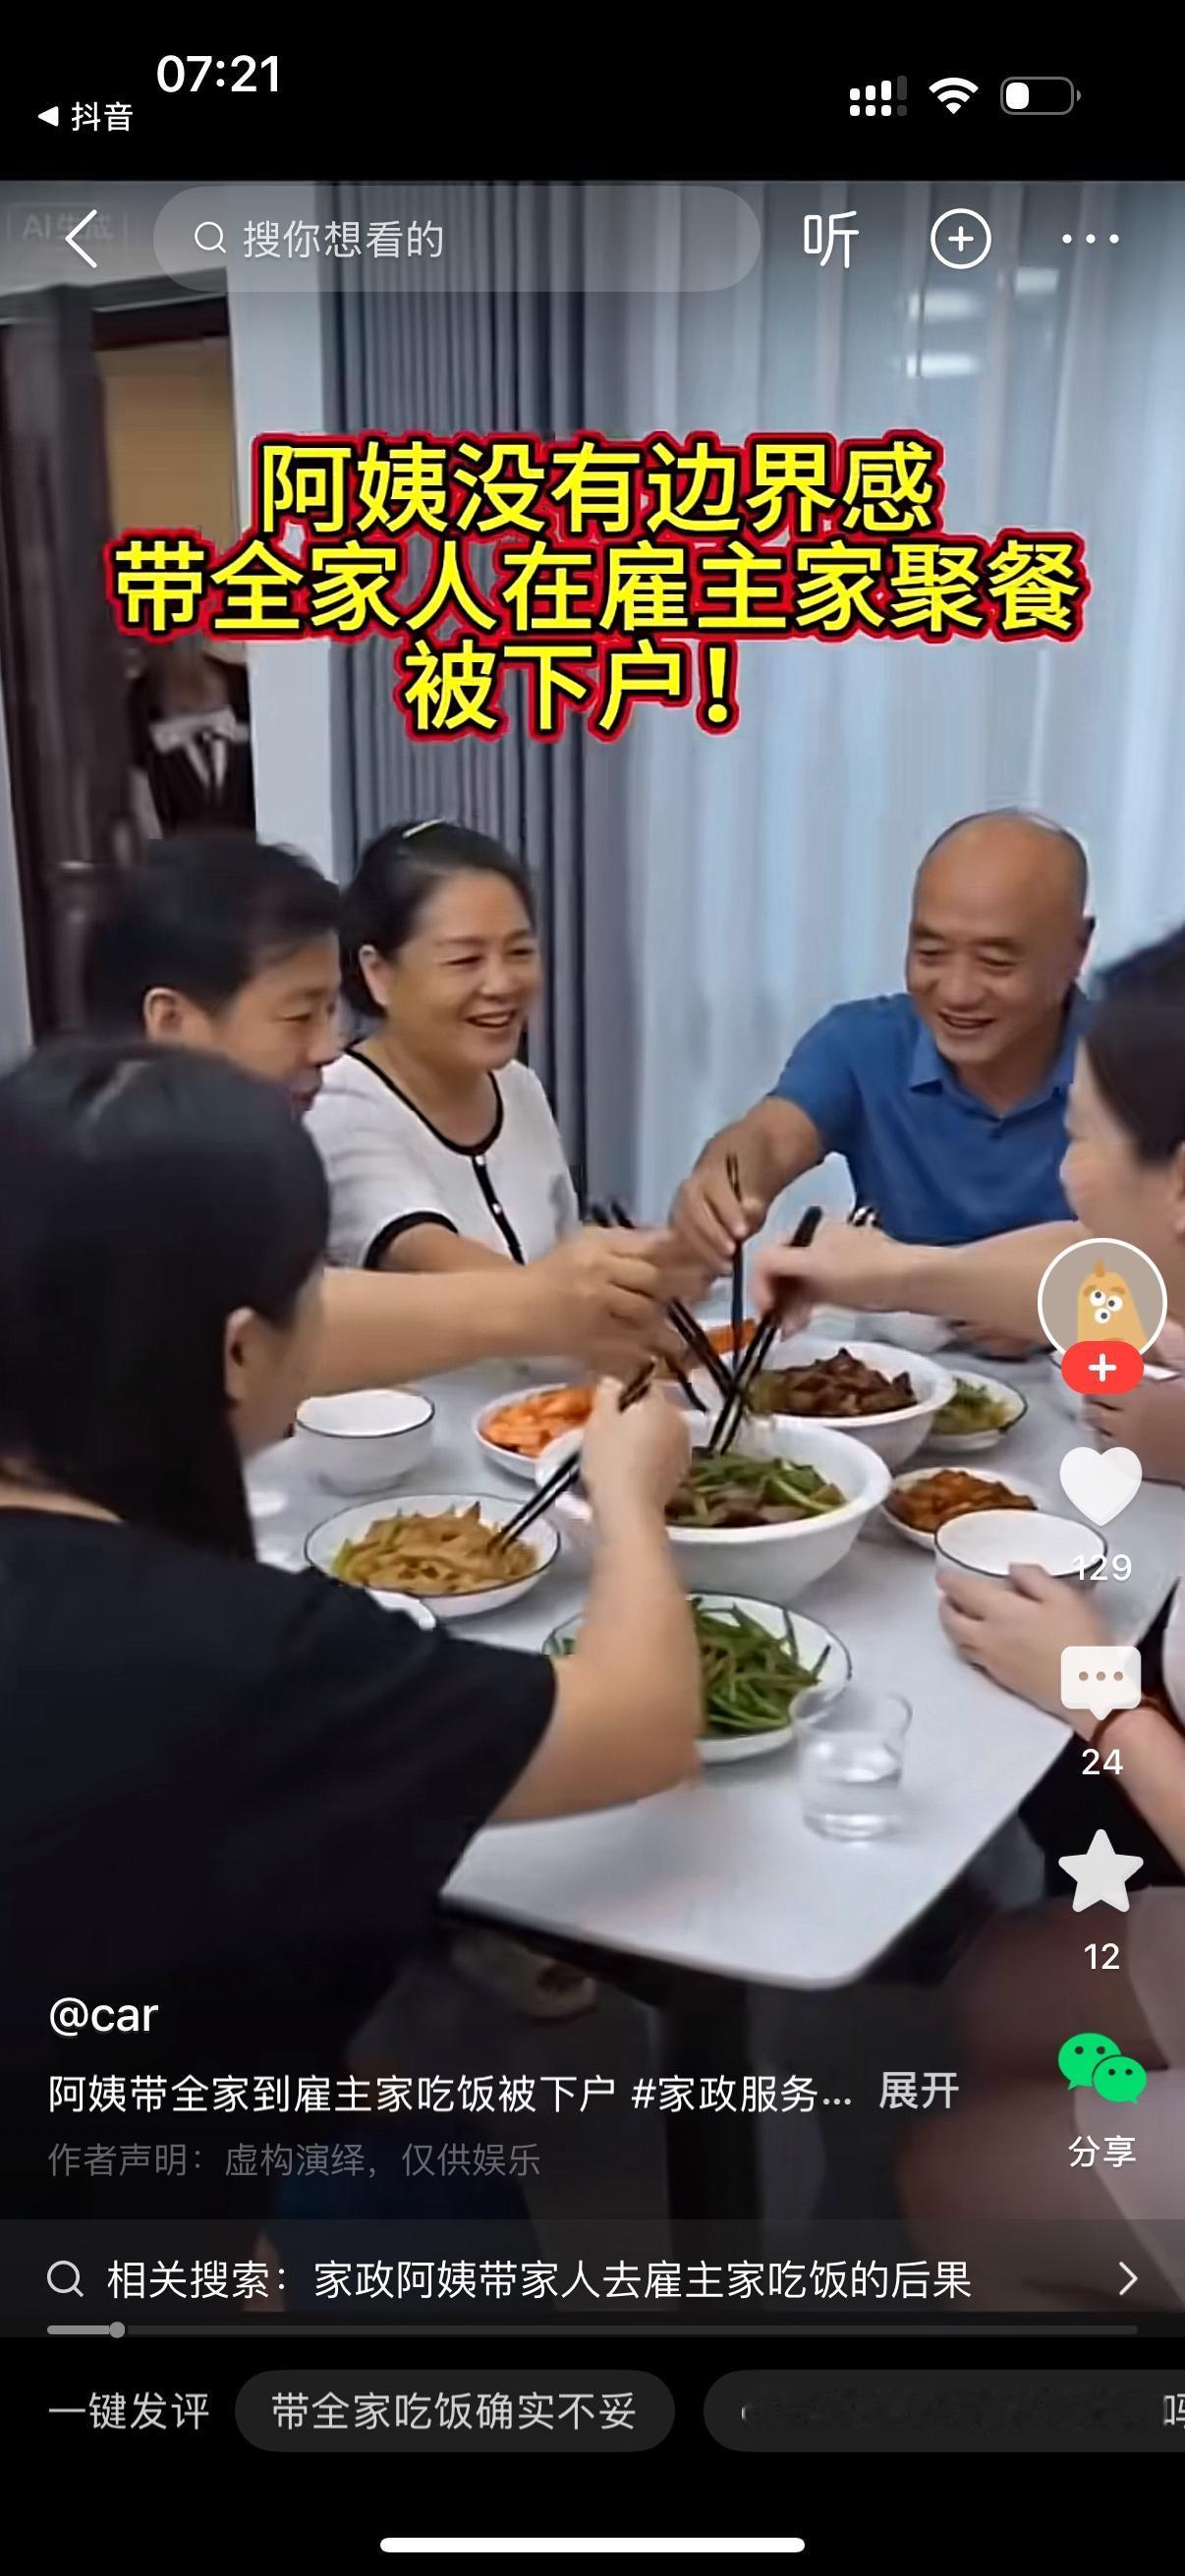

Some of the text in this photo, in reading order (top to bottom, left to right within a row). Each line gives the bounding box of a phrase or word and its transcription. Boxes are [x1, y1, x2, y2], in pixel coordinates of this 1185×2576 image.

[157, 55, 279, 92] 07:21
[72, 101, 134, 132] 抖音
[243, 219, 443, 258] 搜你想看的
[805, 211, 860, 268] 听
[1072, 1553, 1132, 1582] 129
[1082, 1748, 1123, 1775] 24
[1085, 1942, 1119, 1970] 12
[49, 1996, 159, 2037] @car
[49, 2074, 615, 2113] 阿姨带全家到雇主家吃饭被下户
[879, 2071, 959, 2109] 展开
[1068, 2135, 1136, 2167] 分享
[48, 2391, 209, 2431] 一键发评
[271, 2390, 636, 2431] 带全家吃饭确实不妥
